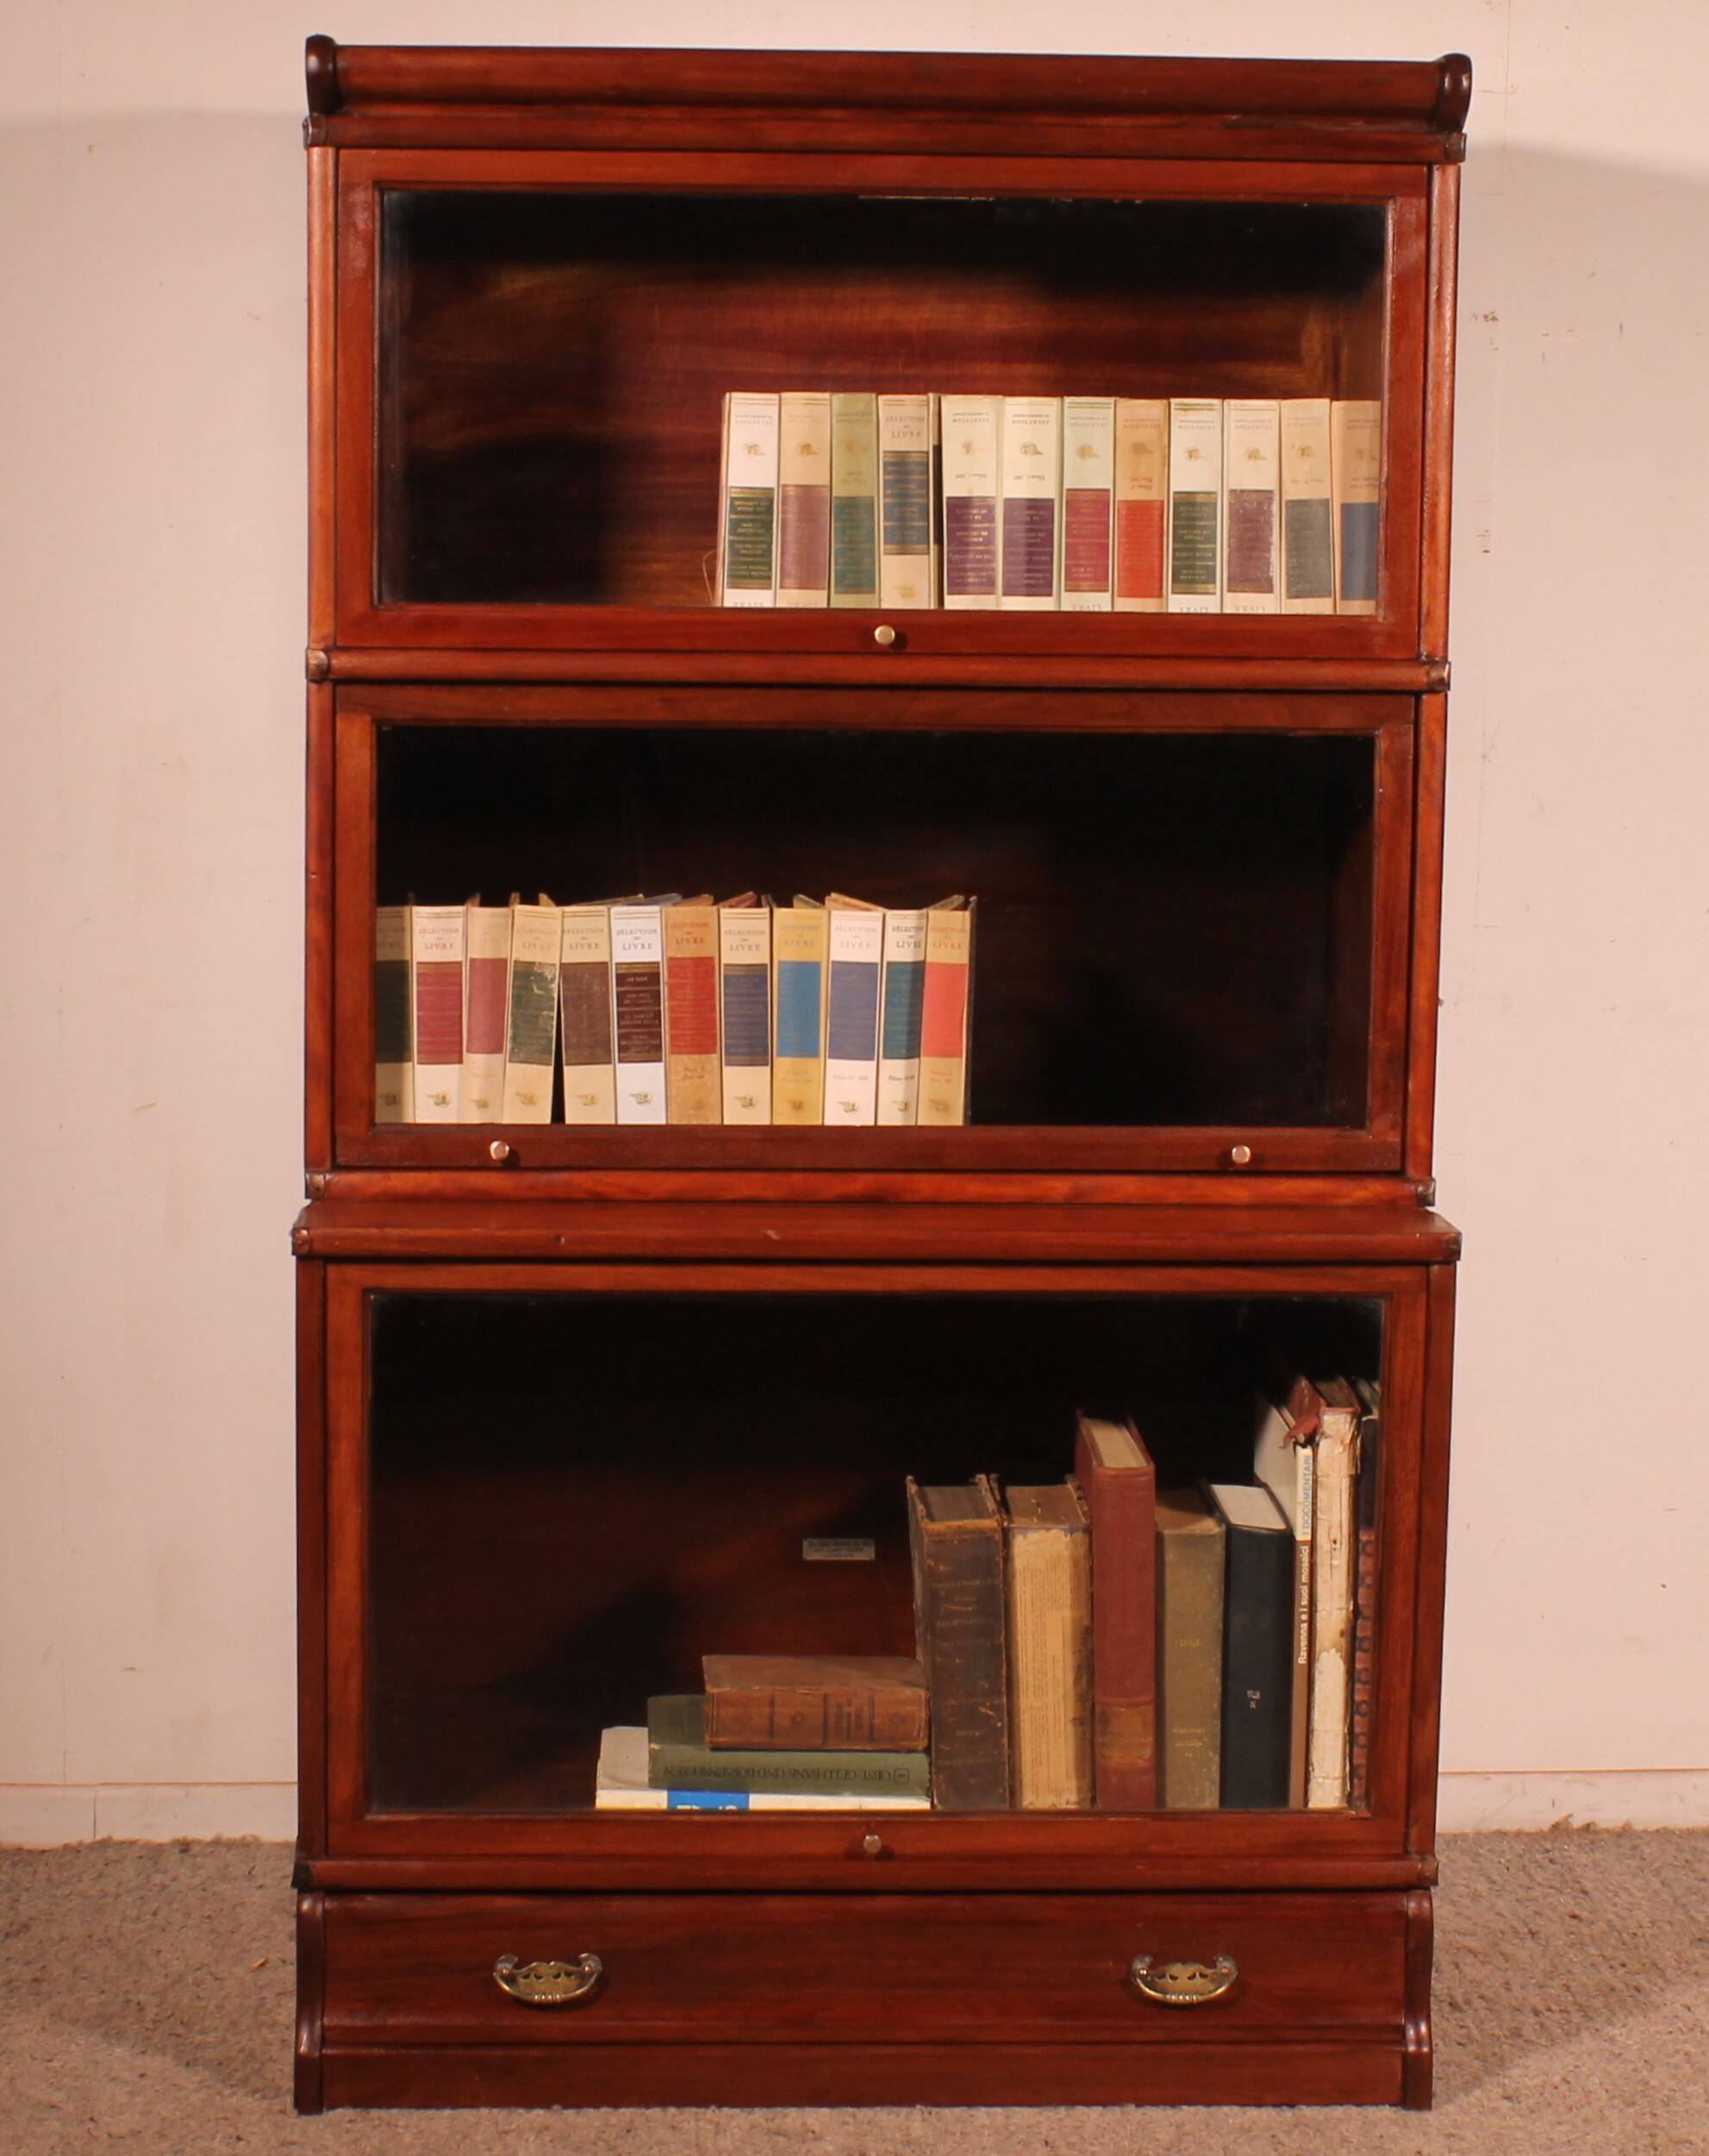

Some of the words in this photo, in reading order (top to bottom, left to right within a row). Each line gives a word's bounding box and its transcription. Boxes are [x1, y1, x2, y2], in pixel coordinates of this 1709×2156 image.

[1302, 1455, 1313, 1526] DOCUMENTARI
[1300, 1545, 1310, 1582] mosaici
[1300, 1585, 1309, 1606] suoi
[1298, 1623, 1308, 1665] Ravenna
